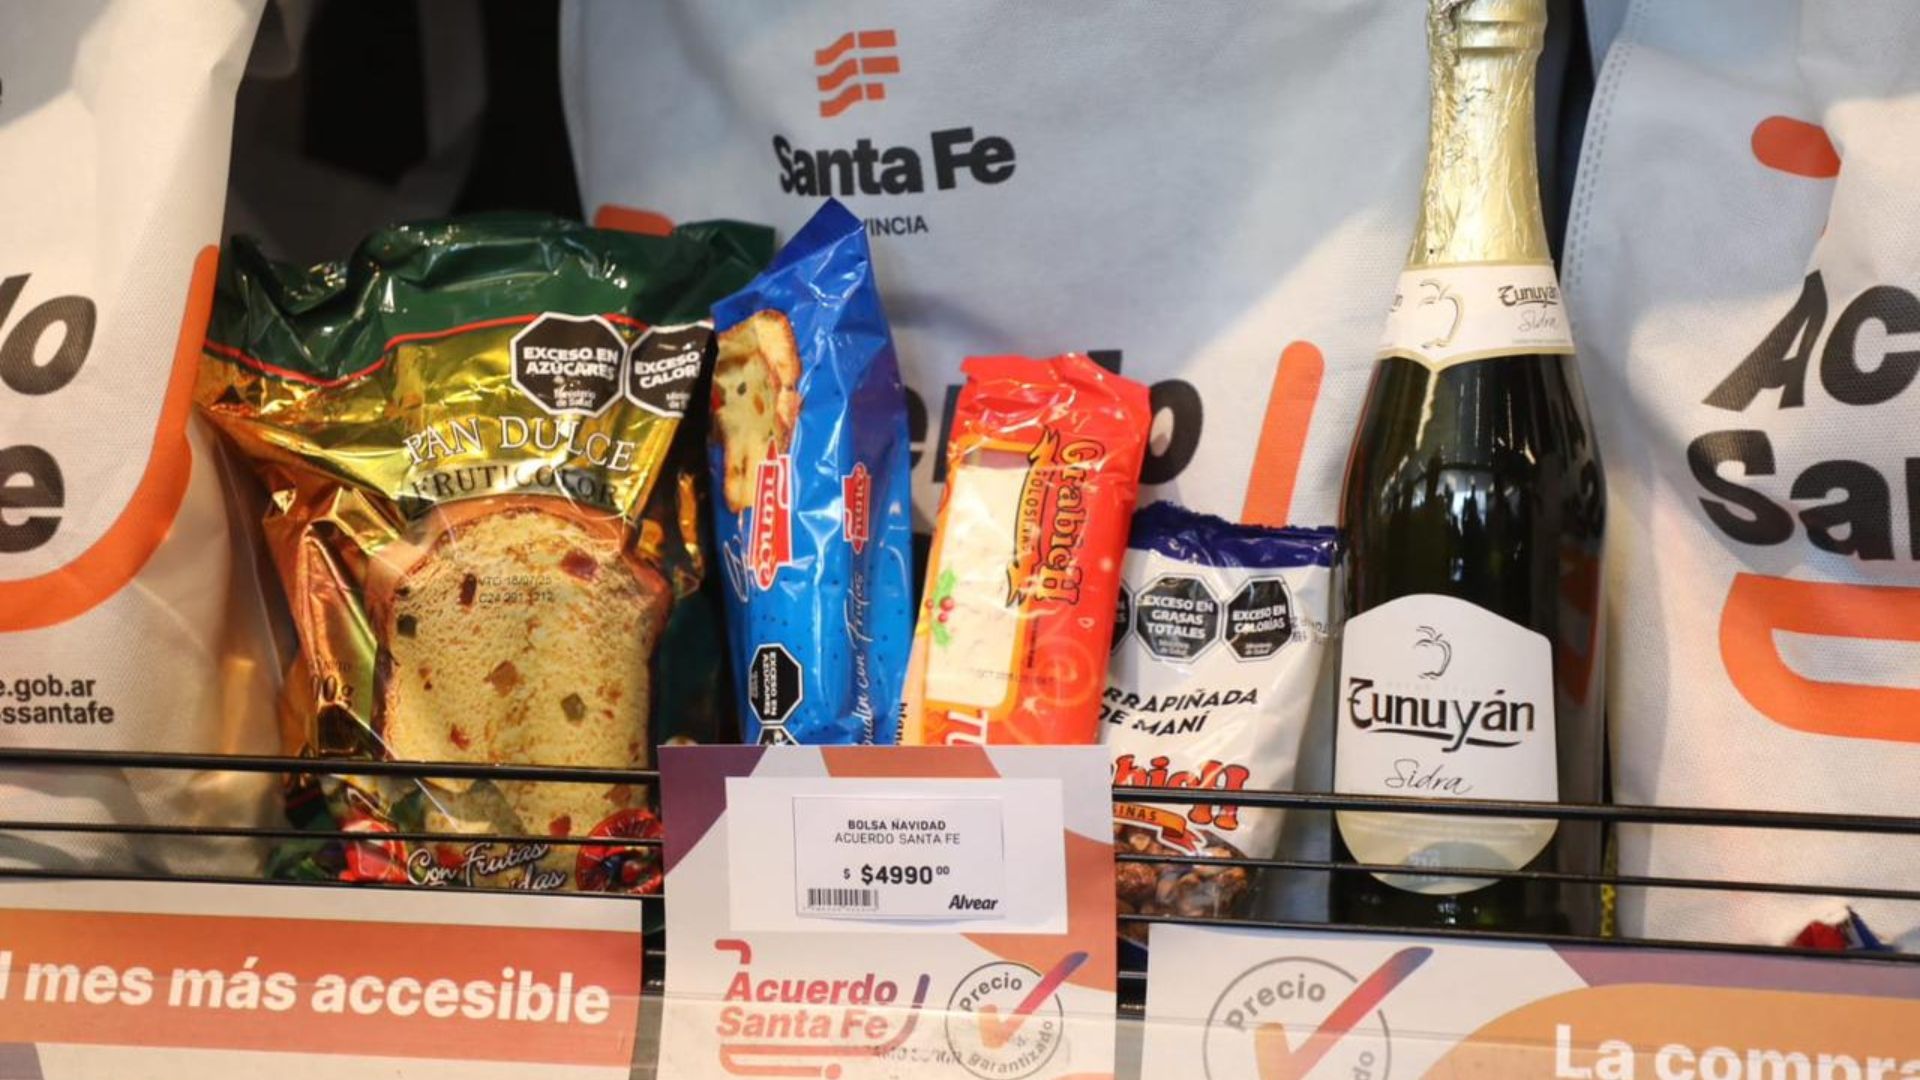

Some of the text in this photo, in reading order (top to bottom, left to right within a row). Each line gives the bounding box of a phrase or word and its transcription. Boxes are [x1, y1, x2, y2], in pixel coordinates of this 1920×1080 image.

[772, 126, 1016, 197] Santa Fe
[863, 215, 928, 237] INCIA
[523, 346, 619, 364] EXCESO EN
[634, 351, 699, 375] EXCESO
[403, 415, 636, 472] PAN DULCE
[411, 464, 618, 500] FRUTICOLOR
[1143, 594, 1214, 613] EXCESO EN
[1151, 608, 1204, 626] GRASAS
[1232, 604, 1286, 621] EXCESO EN
[1146, 624, 1206, 639] TOTALES
[0, 700, 115, 725] ssantafe
[1131, 711, 1210, 737] MANÍ
[1347, 677, 1535, 753] Tunuyán
[1384, 758, 1473, 795] Sidra
[834, 832, 961, 845] ACUERDO SANTA FE
[848, 819, 946, 831] BOLSA NAVIDAD
[407, 842, 549, 887] Con Frutas
[948, 894, 999, 911] Alvear
[24, 962, 154, 1006] mes
[167, 956, 298, 1012] más
[311, 966, 611, 1025] accesible
[724, 971, 898, 1005] Acuerdo
[959, 972, 1022, 1012] Precio
[1224, 973, 1326, 1032] Precio
[716, 1005, 889, 1041] Santa Fe
[967, 1020, 1054, 1074] garantizado
[1555, 1023, 1635, 1080] La
